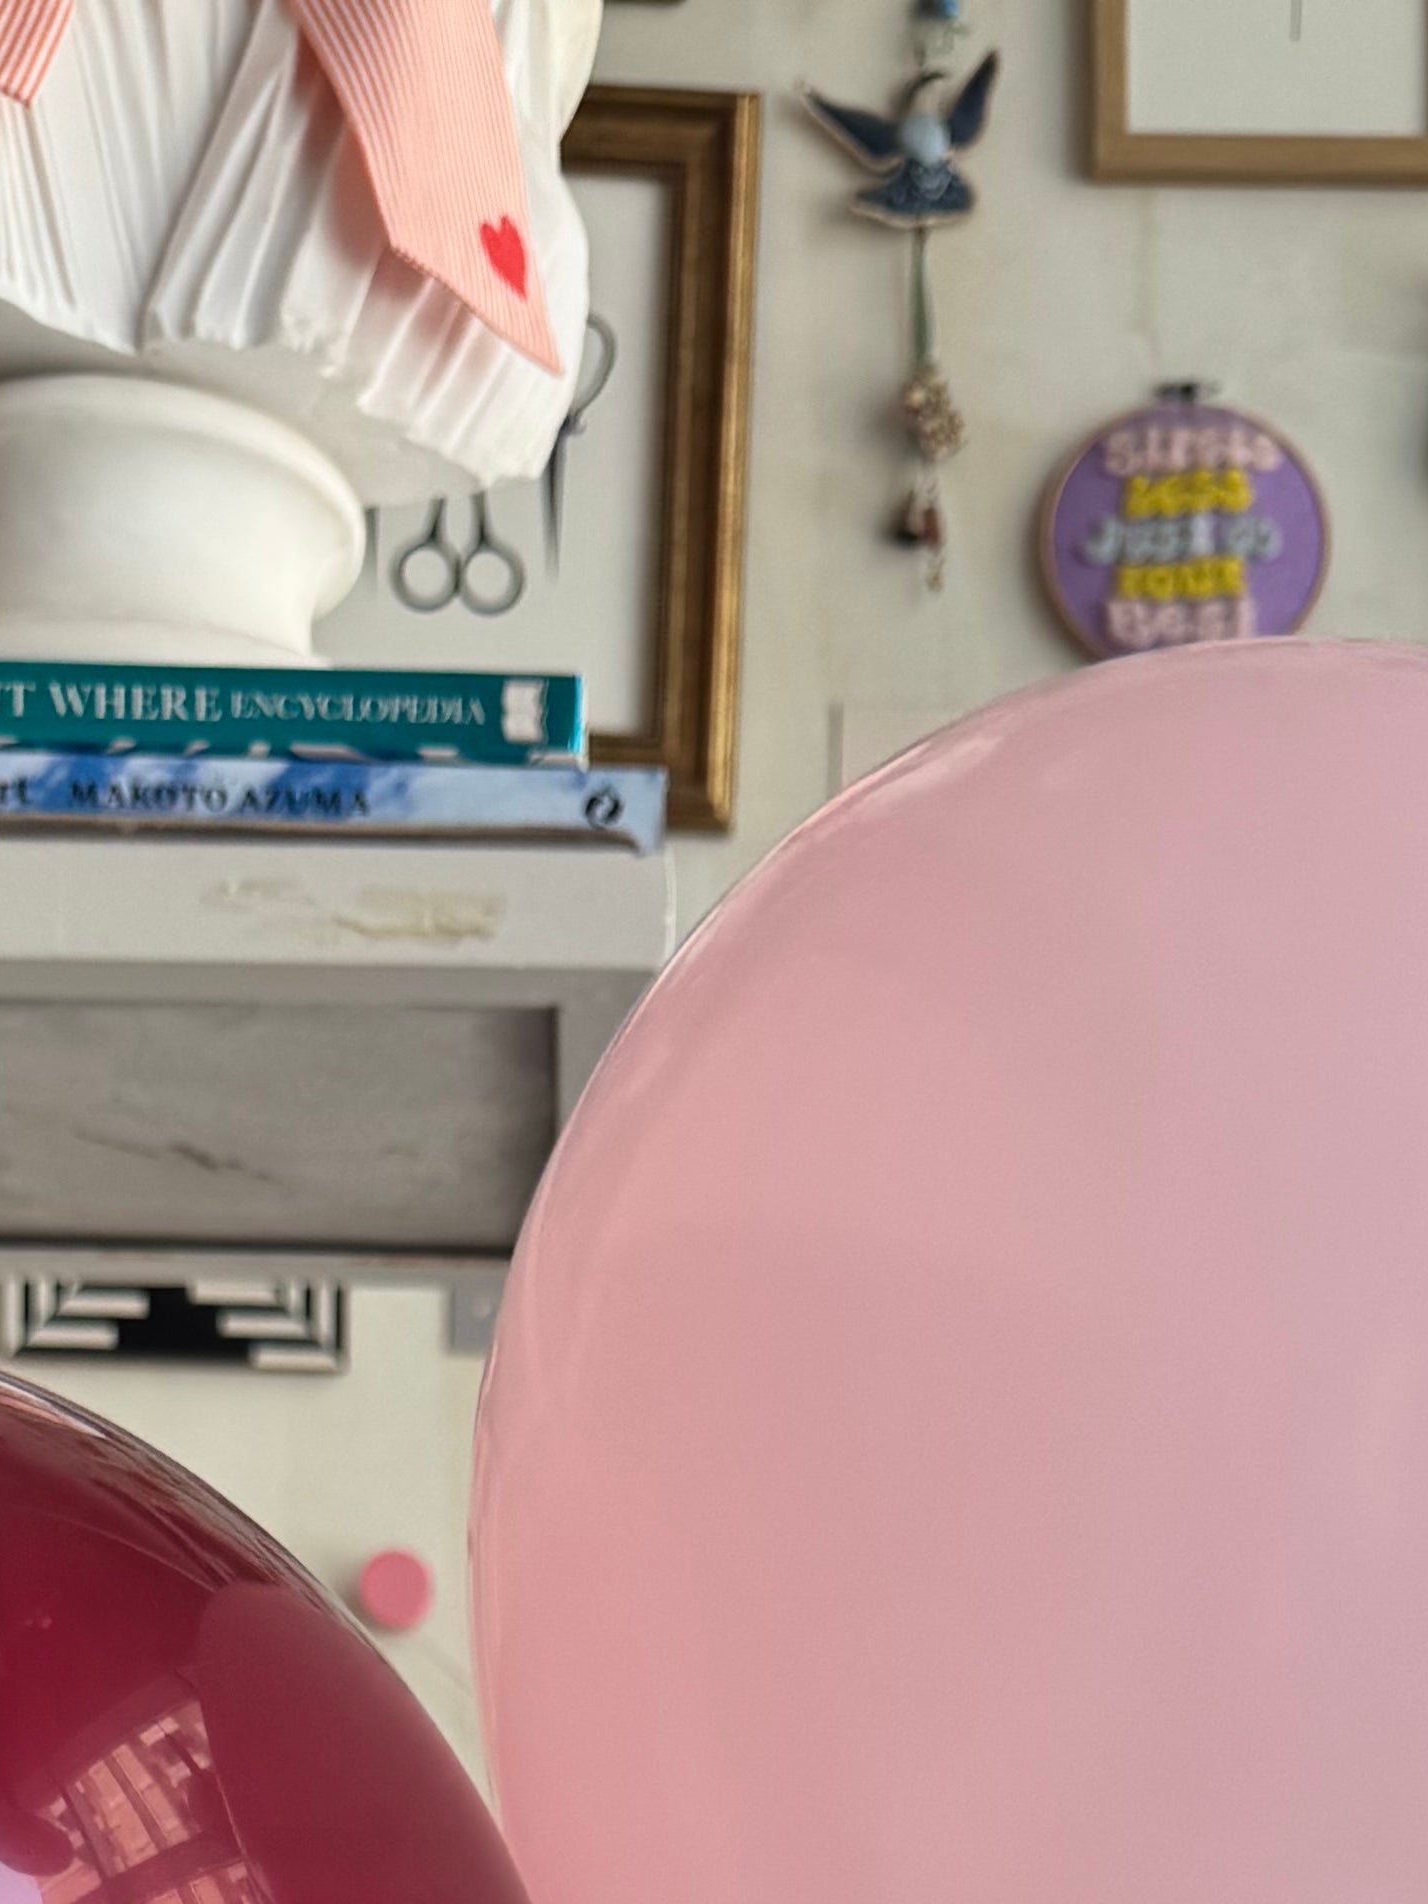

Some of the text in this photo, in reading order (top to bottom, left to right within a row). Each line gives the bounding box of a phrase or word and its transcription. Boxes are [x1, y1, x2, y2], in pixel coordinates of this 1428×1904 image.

[49, 681, 223, 723] WHERE
[230, 688, 486, 727] ENCYCLOPEDIA
[72, 779, 229, 814] MAKOTO
